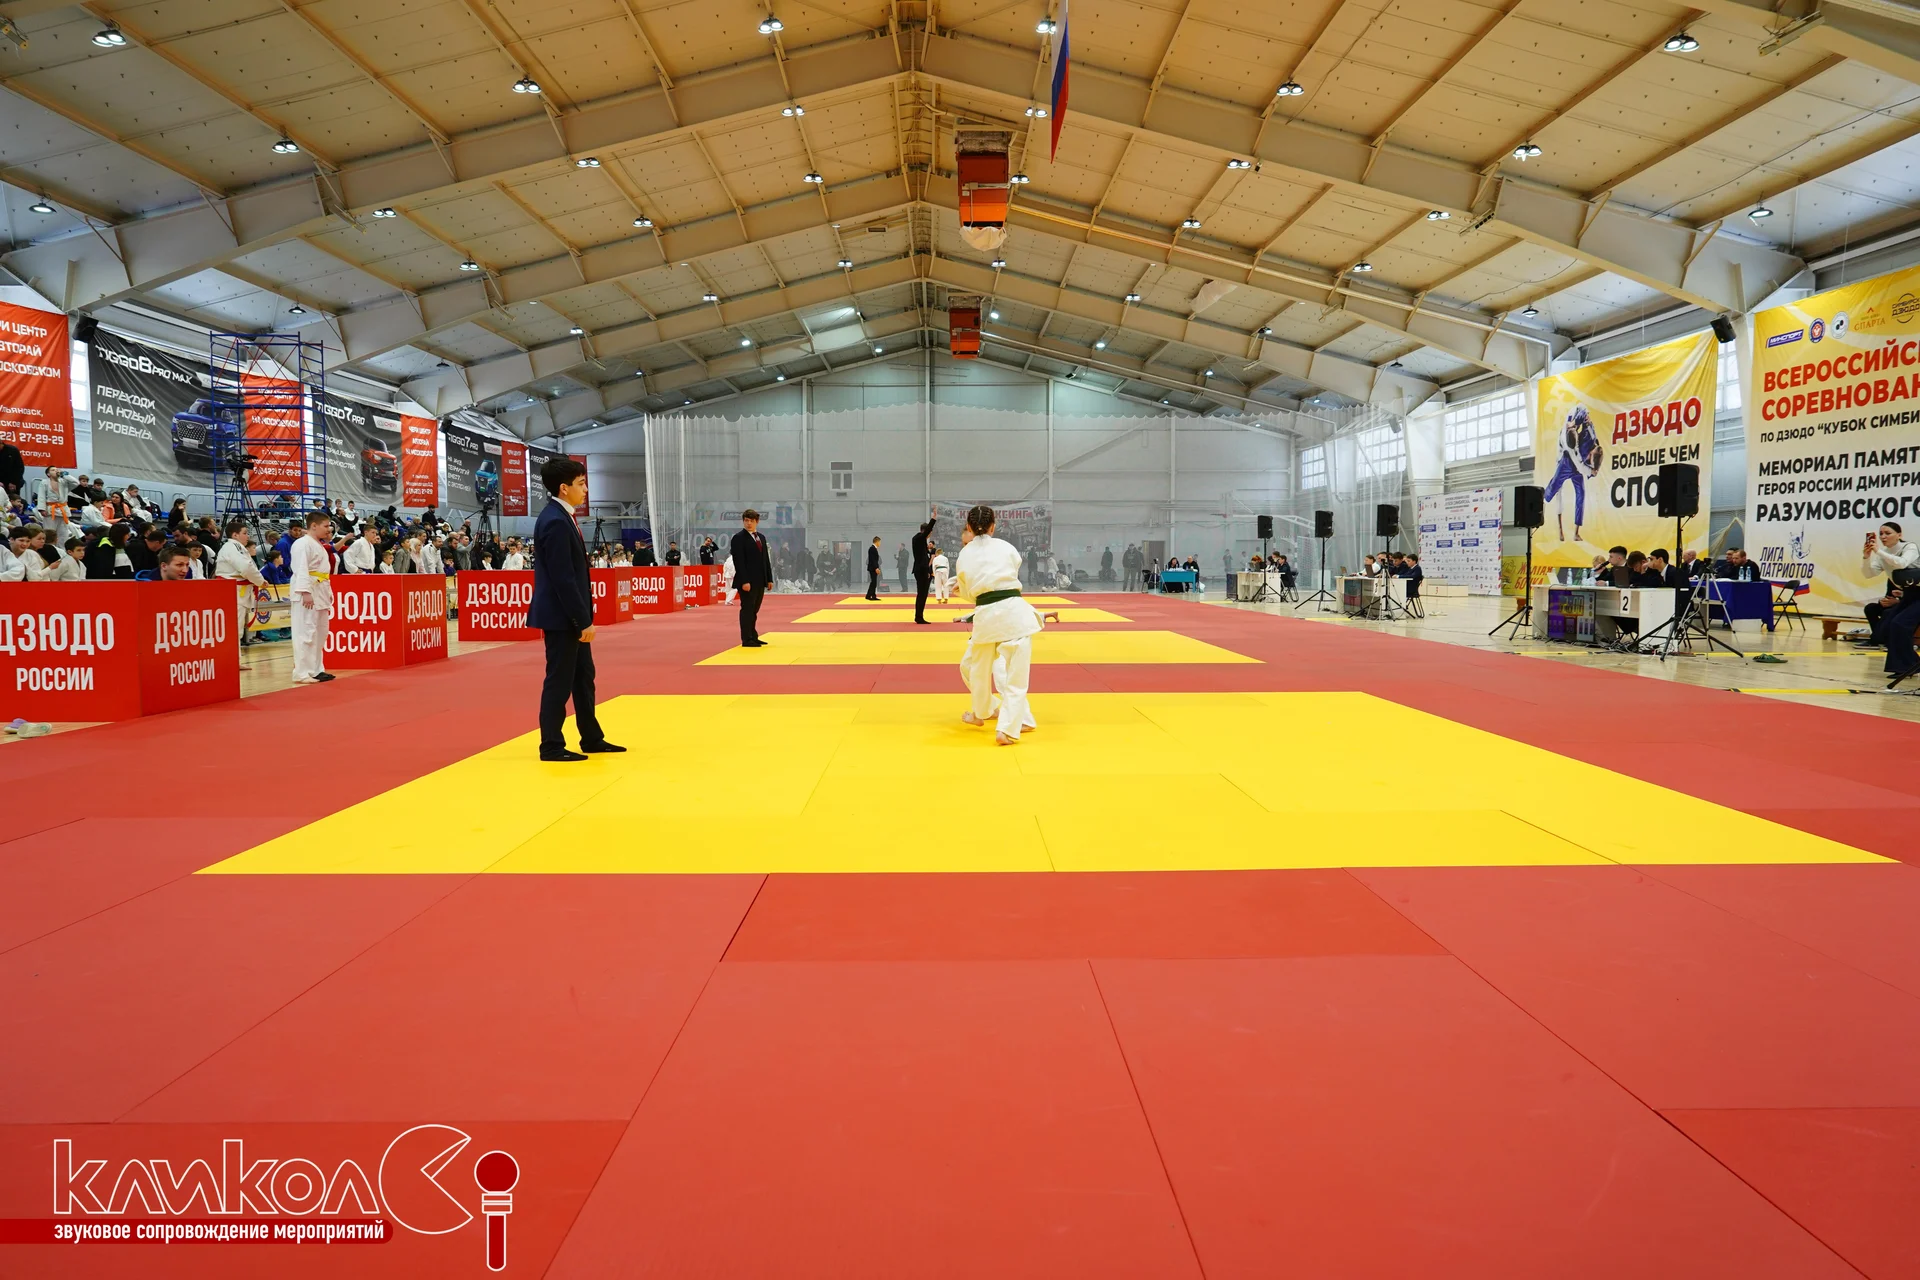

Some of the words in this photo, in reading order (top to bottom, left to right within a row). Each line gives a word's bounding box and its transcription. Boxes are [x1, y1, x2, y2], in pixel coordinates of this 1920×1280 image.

[12, 322, 47, 338] ЦЕНТР
[1853, 318, 1886, 331] СПАРТА
[152, 365, 171, 379] PRO
[172, 371, 193, 385] MAX
[1763, 338, 1920, 393] ВСЕРОССИЙС
[97, 385, 156, 410] ПЕРЕХОДИ
[97, 402, 114, 416] НА
[116, 406, 156, 426] НОВЫЙ
[352, 415, 366, 426] PRO
[1612, 397, 1702, 445] ДЗЮДО
[19, 432, 64, 446] 27-29-29
[1760, 430, 1774, 443] ПО
[1776, 426, 1815, 442] ДЗЮДО
[1612, 448, 1666, 471] БОЛЬШЕ
[1669, 443, 1700, 463] ЧЕМ
[1759, 453, 1849, 477] МЕМОРИАЛ
[1611, 474, 1660, 509] СПО
[1757, 481, 1795, 496] ГЕРОЯ
[1799, 477, 1852, 493] РОССИИ
[1759, 547, 1784, 562] ЛИГА
[1759, 562, 1815, 579] ПАТРИОТОВ
[632, 577, 666, 592] ЗЮДО
[1514, 576, 1544, 590] БОКА
[327, 591, 393, 624] ЮДО
[407, 589, 443, 623] ДЗЮДО
[465, 583, 533, 608] ДЗЮДО
[1622, 596, 1629, 612] 2
[154, 608, 226, 654] ДЗЮДО
[471, 612, 528, 629] РОССИИ
[0, 613, 115, 656] ДЗЮДО
[323, 630, 386, 653] ОССИИ
[411, 626, 442, 651] РОССИИ
[16, 667, 94, 691] РОССИИ
[170, 658, 215, 686] РОССИИ
